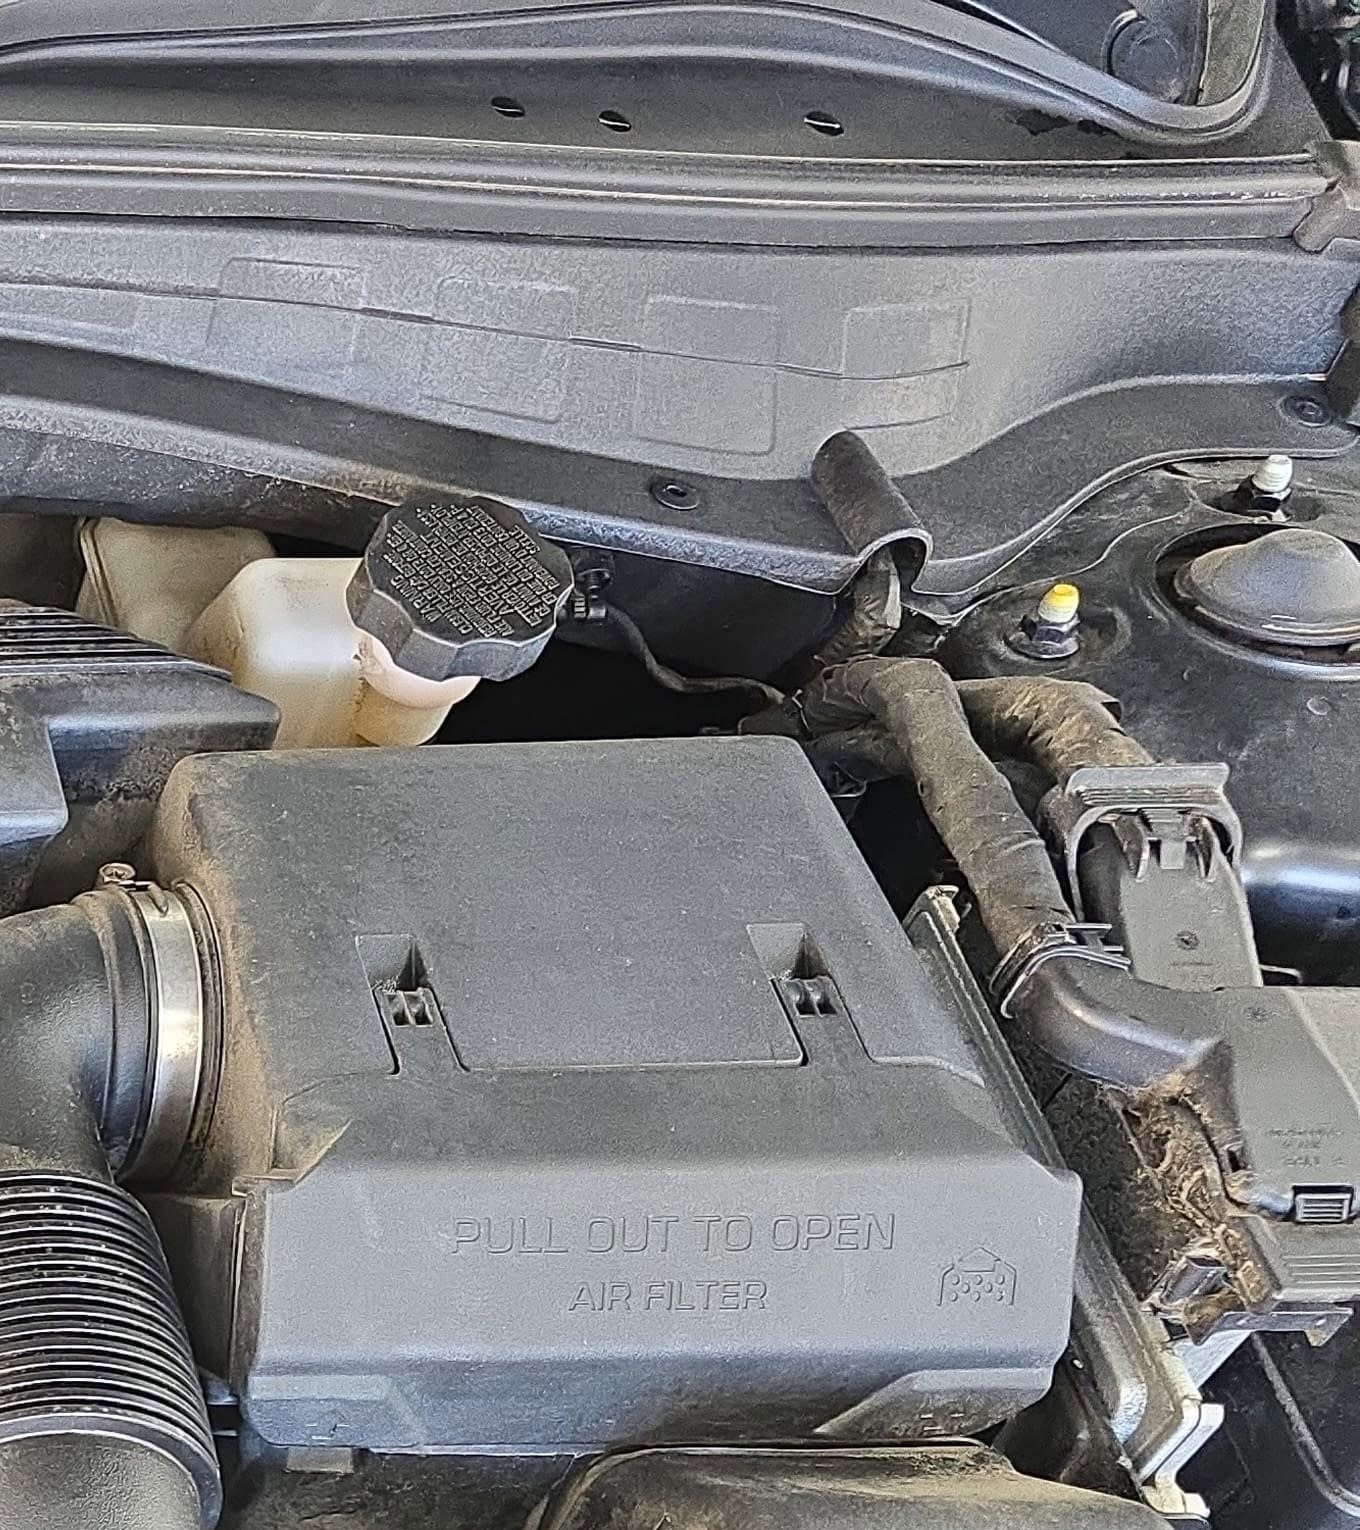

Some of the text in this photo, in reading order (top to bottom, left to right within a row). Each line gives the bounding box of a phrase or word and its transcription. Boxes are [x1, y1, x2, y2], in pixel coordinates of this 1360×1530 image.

[418, 530, 514, 616] AVERTISSEMENT
[388, 574, 443, 622] WARNING
[452, 1212, 896, 1254] PULL OUT TO OPEN
[568, 1279, 768, 1311] AIR FILTER
